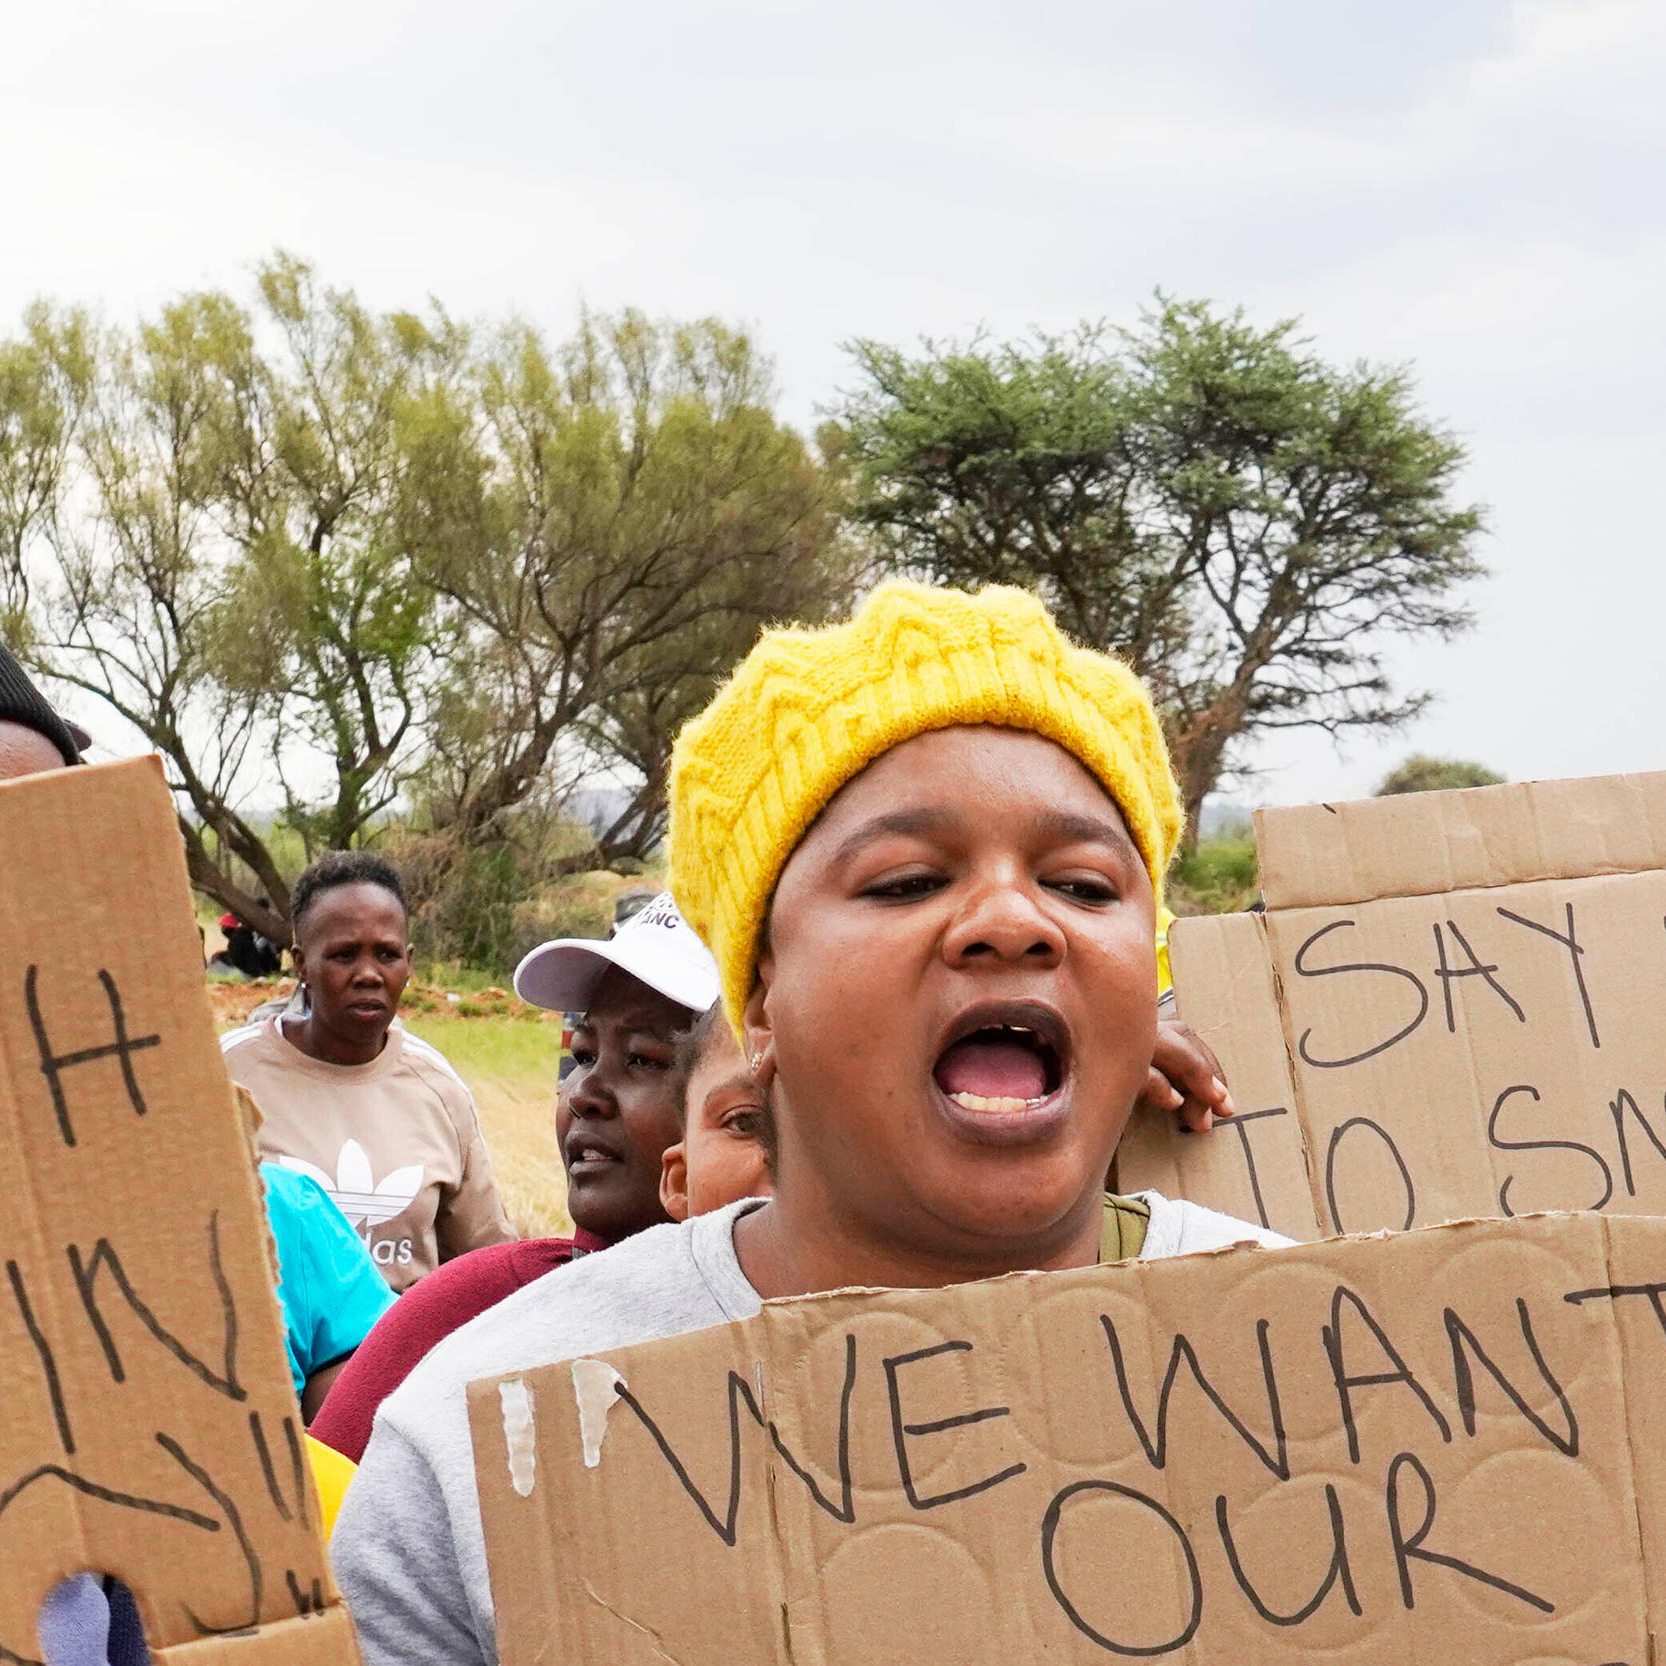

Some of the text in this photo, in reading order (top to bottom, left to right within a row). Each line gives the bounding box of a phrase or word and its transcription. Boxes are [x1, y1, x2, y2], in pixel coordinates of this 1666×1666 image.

[1294, 901, 1600, 1067] SAY
[1179, 1106, 1415, 1235] TO
[6, 1211, 247, 1453] IN
[614, 1333, 1026, 1547] WE
[1042, 1452, 1554, 1655] OUR
